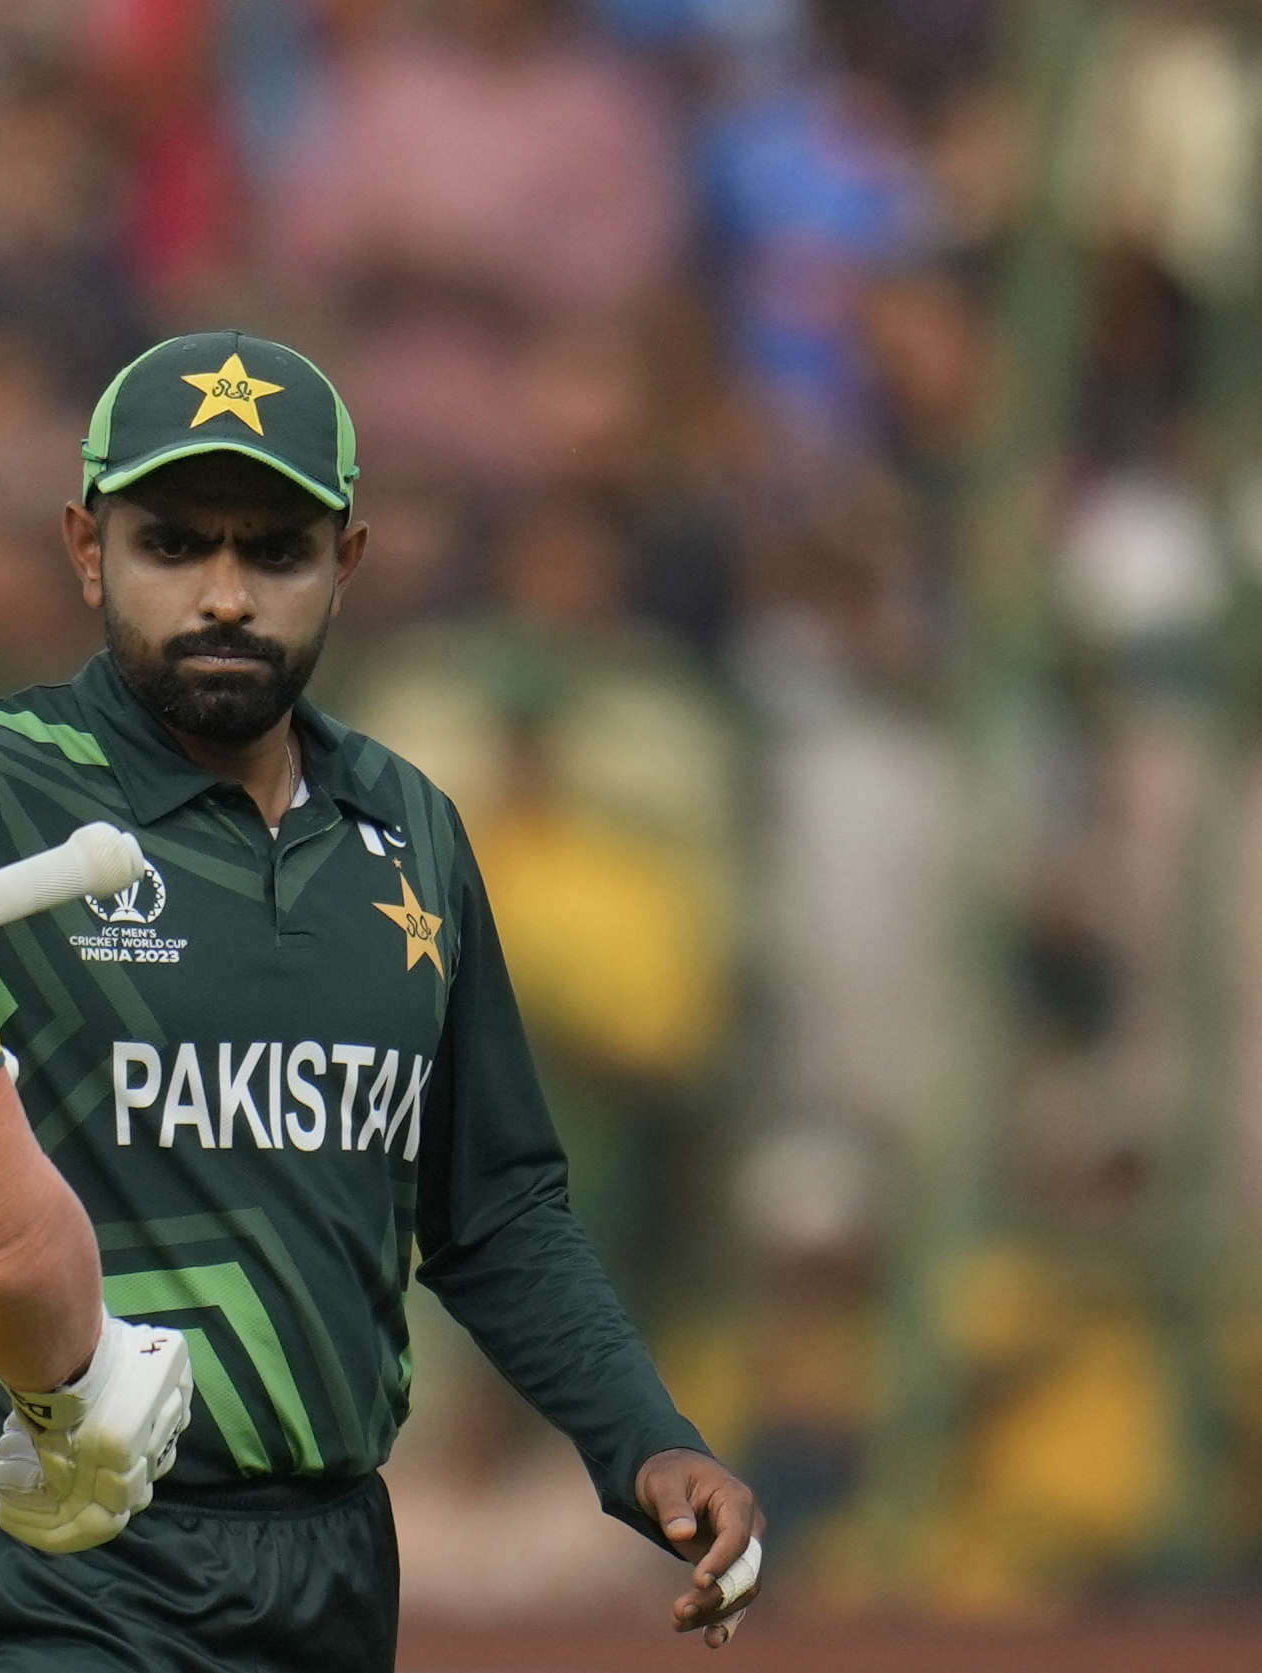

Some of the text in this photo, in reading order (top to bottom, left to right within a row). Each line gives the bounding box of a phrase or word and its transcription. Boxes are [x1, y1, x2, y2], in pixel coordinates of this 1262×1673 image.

[101, 926, 157, 939] ICC MEN'S
[69, 935, 188, 950] CRICKET WORLD CUP
[80, 947, 180, 964] INDIA 2023
[112, 1039, 433, 1163] PAKISTAN
